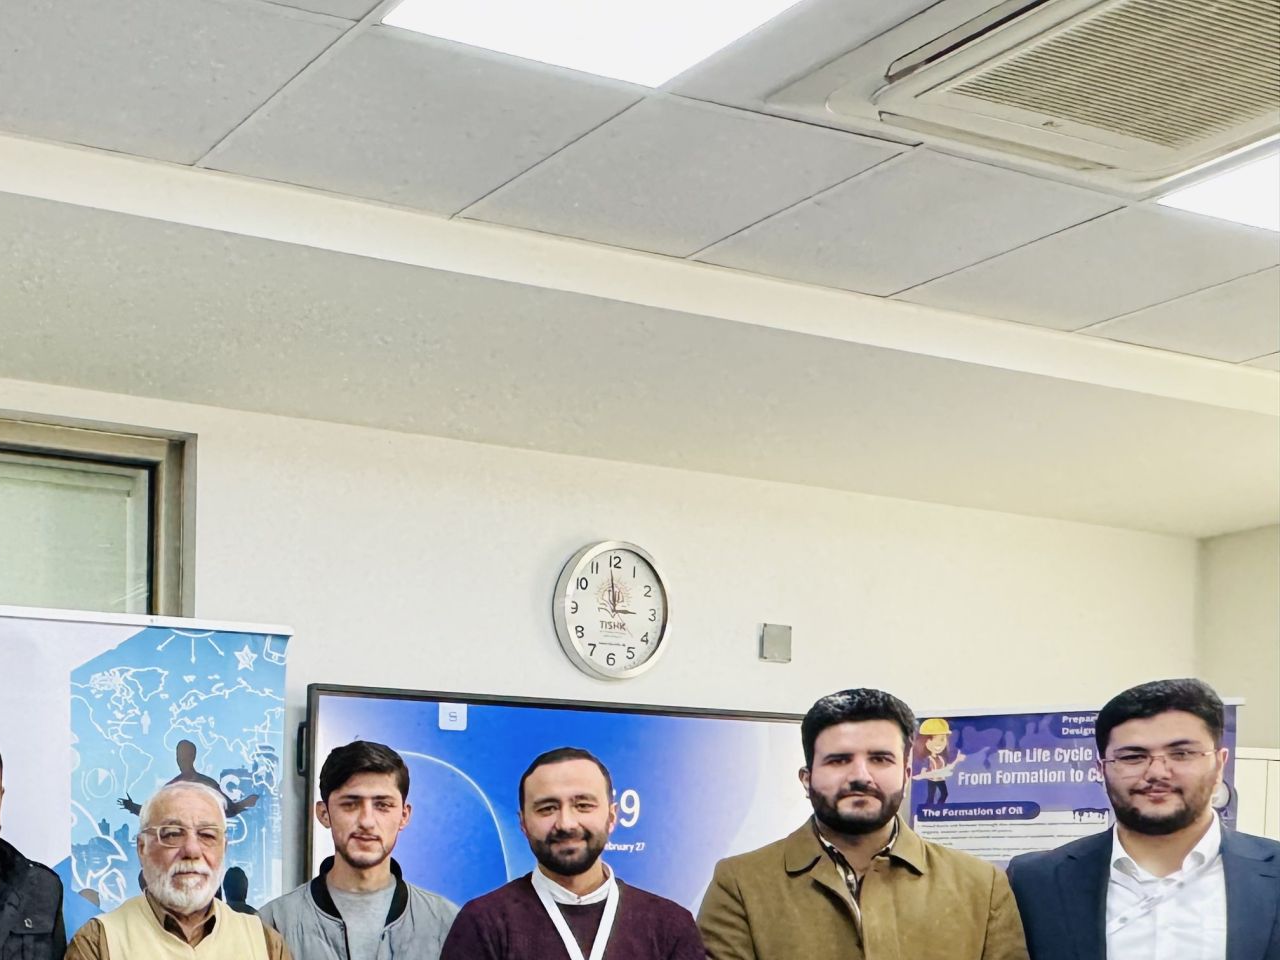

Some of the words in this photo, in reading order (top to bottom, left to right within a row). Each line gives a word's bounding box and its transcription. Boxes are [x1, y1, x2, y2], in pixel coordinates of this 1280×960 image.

[590, 561, 599, 575] 11
[609, 555, 622, 569] 12
[632, 566, 636, 579] 1
[576, 577, 589, 590] 10
[643, 585, 652, 598] 2
[570, 601, 579, 614] 9
[648, 608, 657, 622] 3
[574, 625, 585, 639] 8
[640, 631, 649, 645] 4
[587, 643, 597, 657] 7
[625, 646, 636, 660] 5
[606, 653, 616, 666] 6
[998, 748, 1022, 763] The
[1025, 747, 1051, 763] Life
[1054, 747, 1093, 763] Cycle
[958, 771, 991, 786] From
[996, 769, 1066, 784] Formation
[1070, 768, 1084, 783] to
[922, 808, 941, 818] The
[942, 808, 993, 817] Formation
[993, 806, 1006, 816] of
[1008, 805, 1023, 815] Oil
